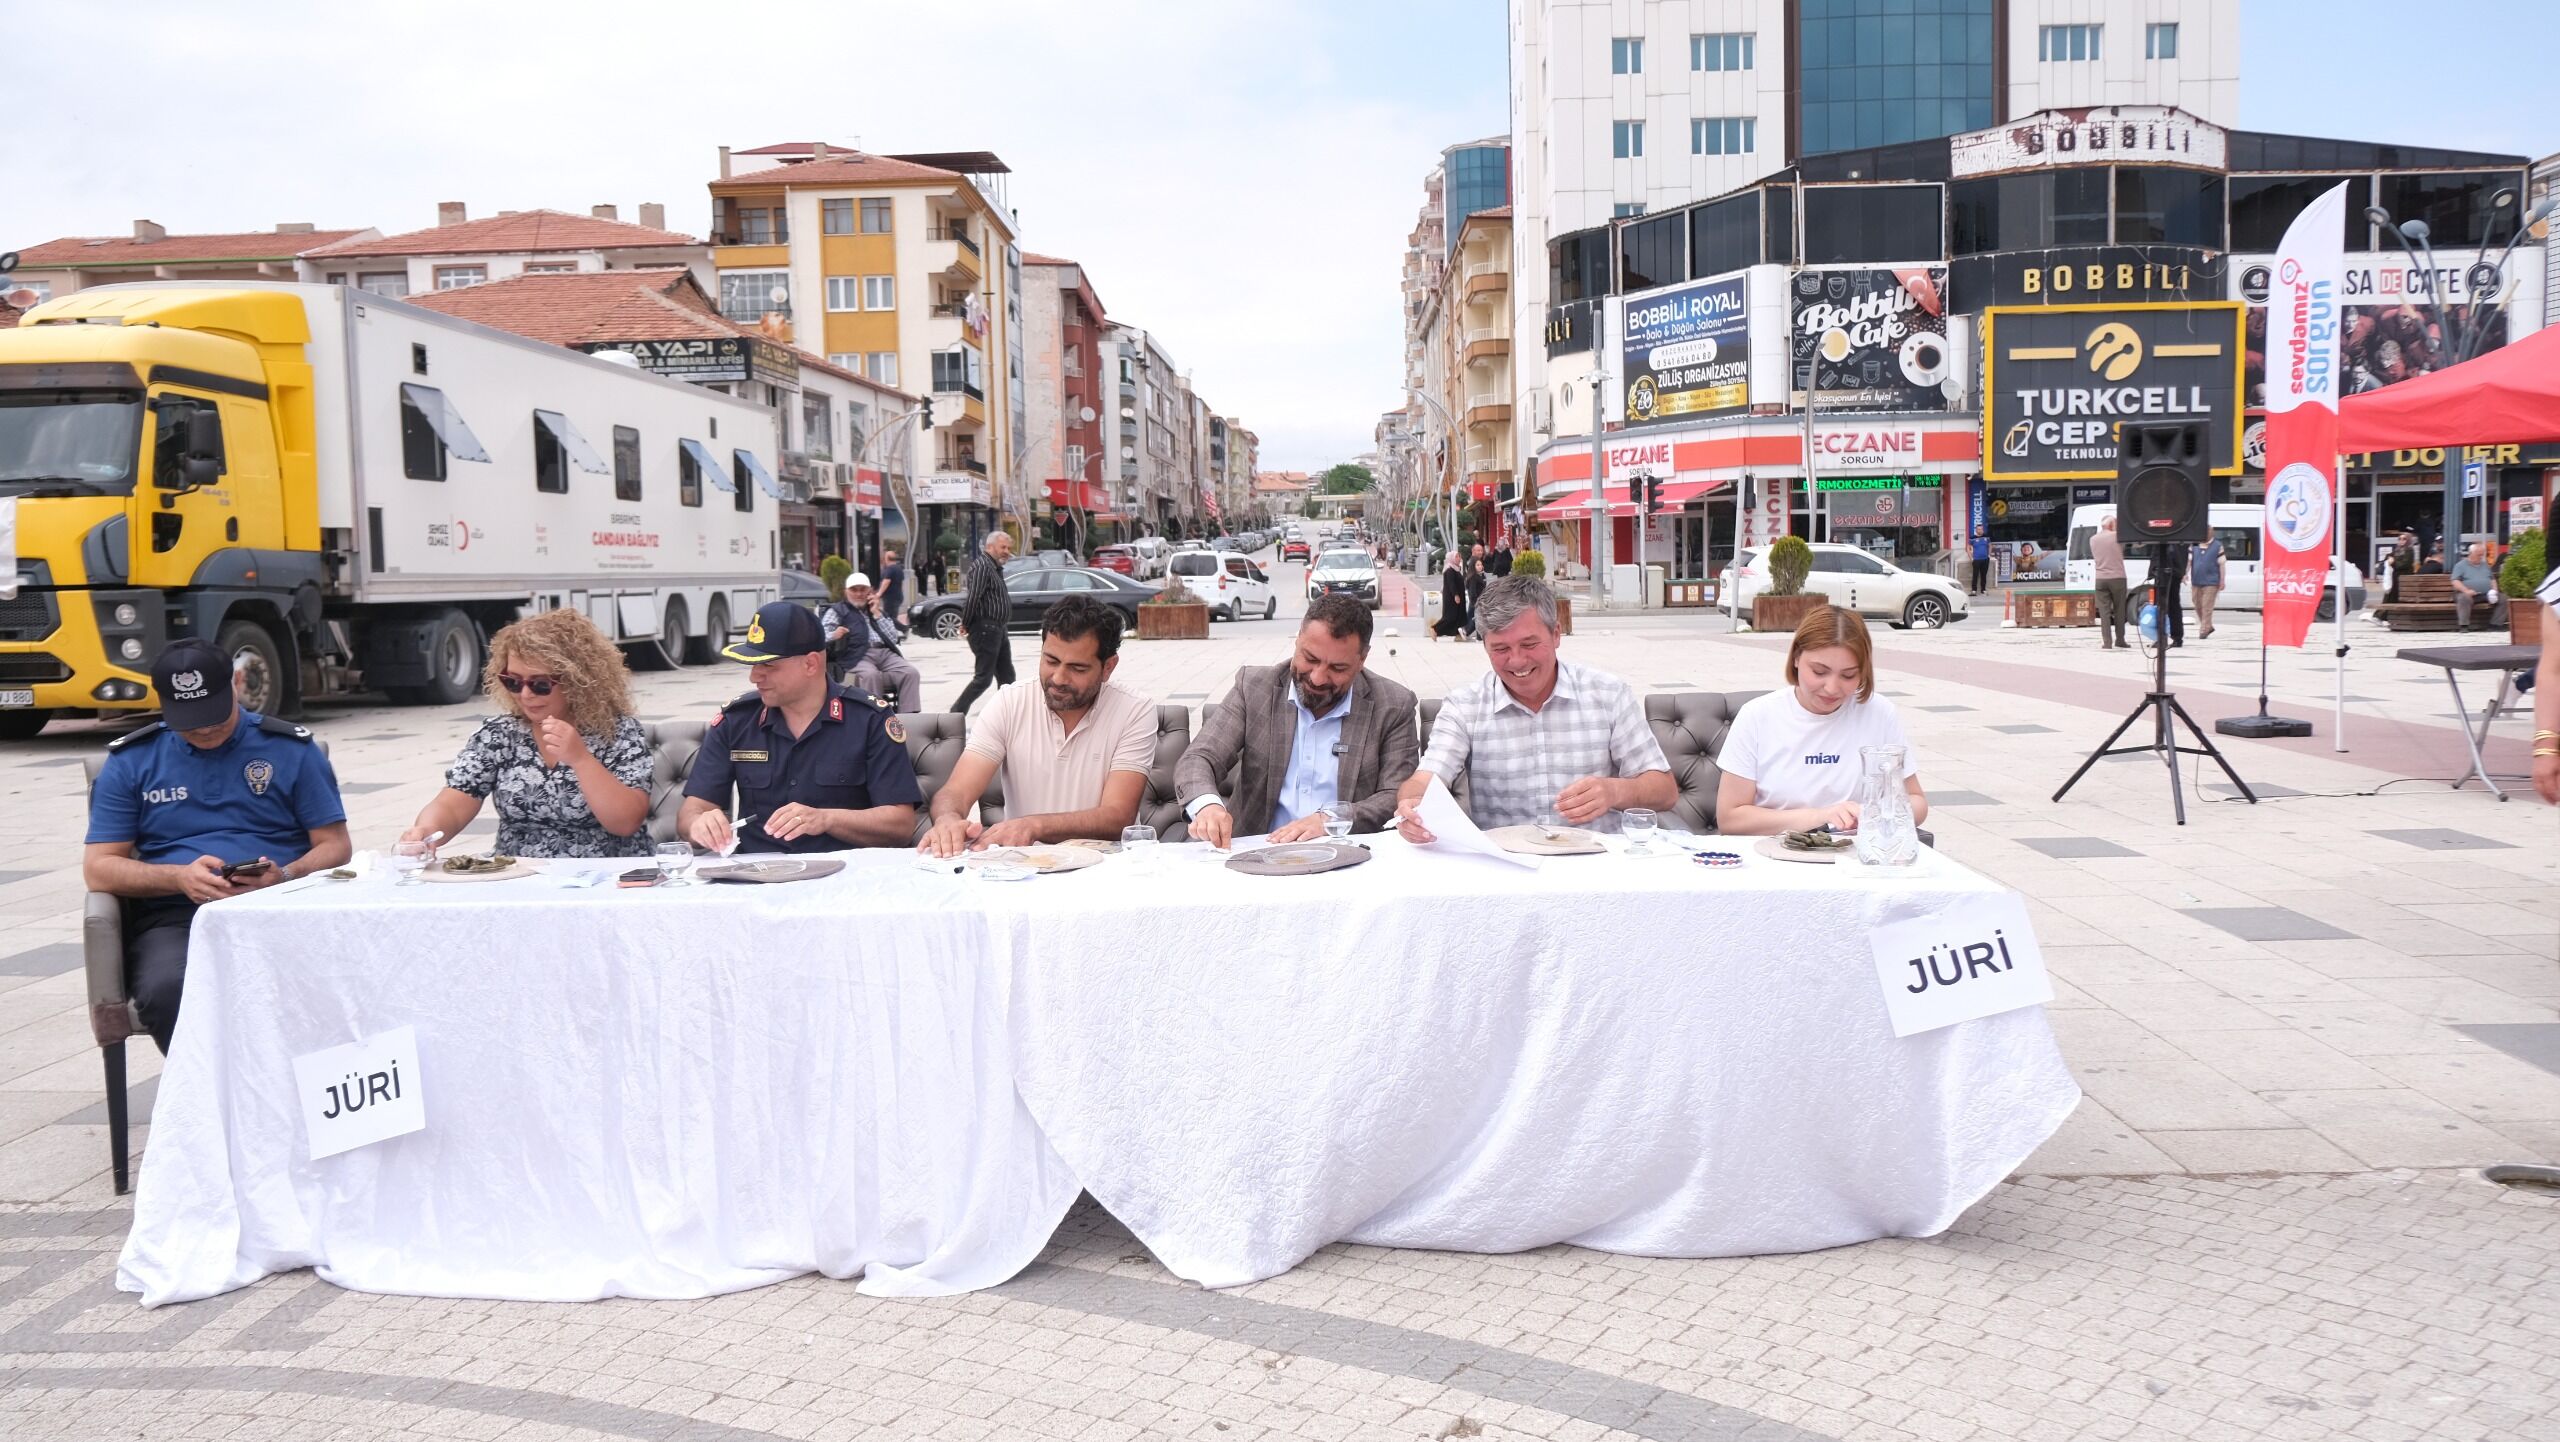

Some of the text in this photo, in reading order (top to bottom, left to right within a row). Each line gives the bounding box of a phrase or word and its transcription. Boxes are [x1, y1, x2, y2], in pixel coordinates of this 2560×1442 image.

[2342, 268, 2374, 296] SA
[2381, 269, 2402, 295] DE
[1628, 290, 1741, 330] BOBBİLİ ROYAL
[1646, 329, 1663, 341] Balo
[1664, 325, 1670, 337] &
[1696, 317, 1722, 331] Salonu
[1850, 314, 1908, 349] Cafe
[2305, 280, 2337, 394] sorgun
[653, 340, 714, 357] YAPI
[1684, 360, 1747, 384] ORGANİZASYON
[1813, 391, 1858, 406] okasyonun
[1860, 392, 1872, 402] En
[2016, 386, 2212, 417] TURKCELL
[1812, 431, 1916, 453] ECZANE
[2036, 421, 2108, 446] CEP
[1611, 442, 1670, 467] ECZANE
[1840, 455, 1884, 465] SORGUN
[2055, 448, 2118, 460] TEKNOLOJ
[1483, 485, 1491, 497] E
[2468, 470, 2479, 491] D
[2008, 500, 2056, 510] TURKCELL
[1647, 514, 1656, 529] E
[1833, 511, 1937, 528] eczane sorgun
[592, 531, 625, 546] CANDAN
[1804, 752, 1841, 765] miav
[1906, 929, 2014, 995] JÜRİ
[322, 1059, 401, 1120] JÜRİ
